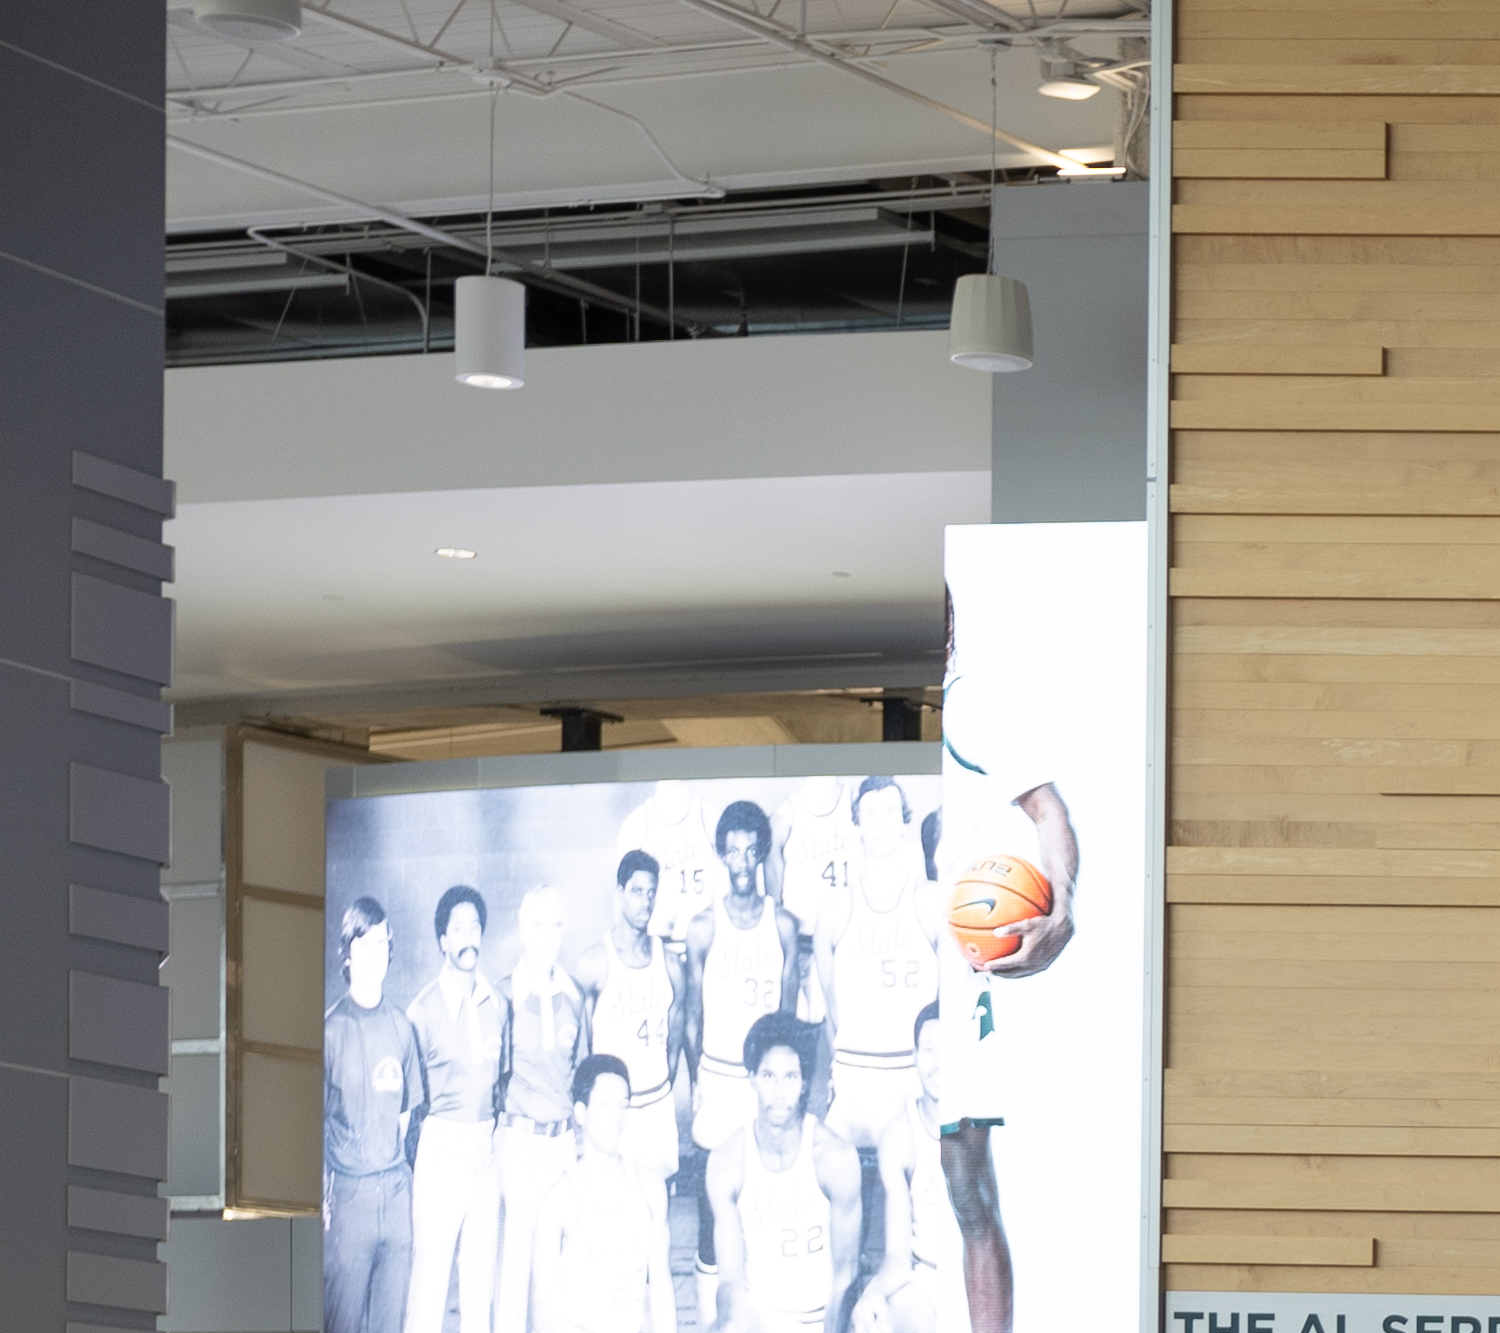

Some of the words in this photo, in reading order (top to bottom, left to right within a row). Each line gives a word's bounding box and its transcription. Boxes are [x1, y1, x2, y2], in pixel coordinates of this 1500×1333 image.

[680, 869, 704, 894] 15
[822, 860, 849, 887] 41
[882, 960, 919, 988] 52
[744, 979, 774, 1008] 32
[637, 1018, 663, 1047] 44
[781, 1225, 823, 1257] 22
